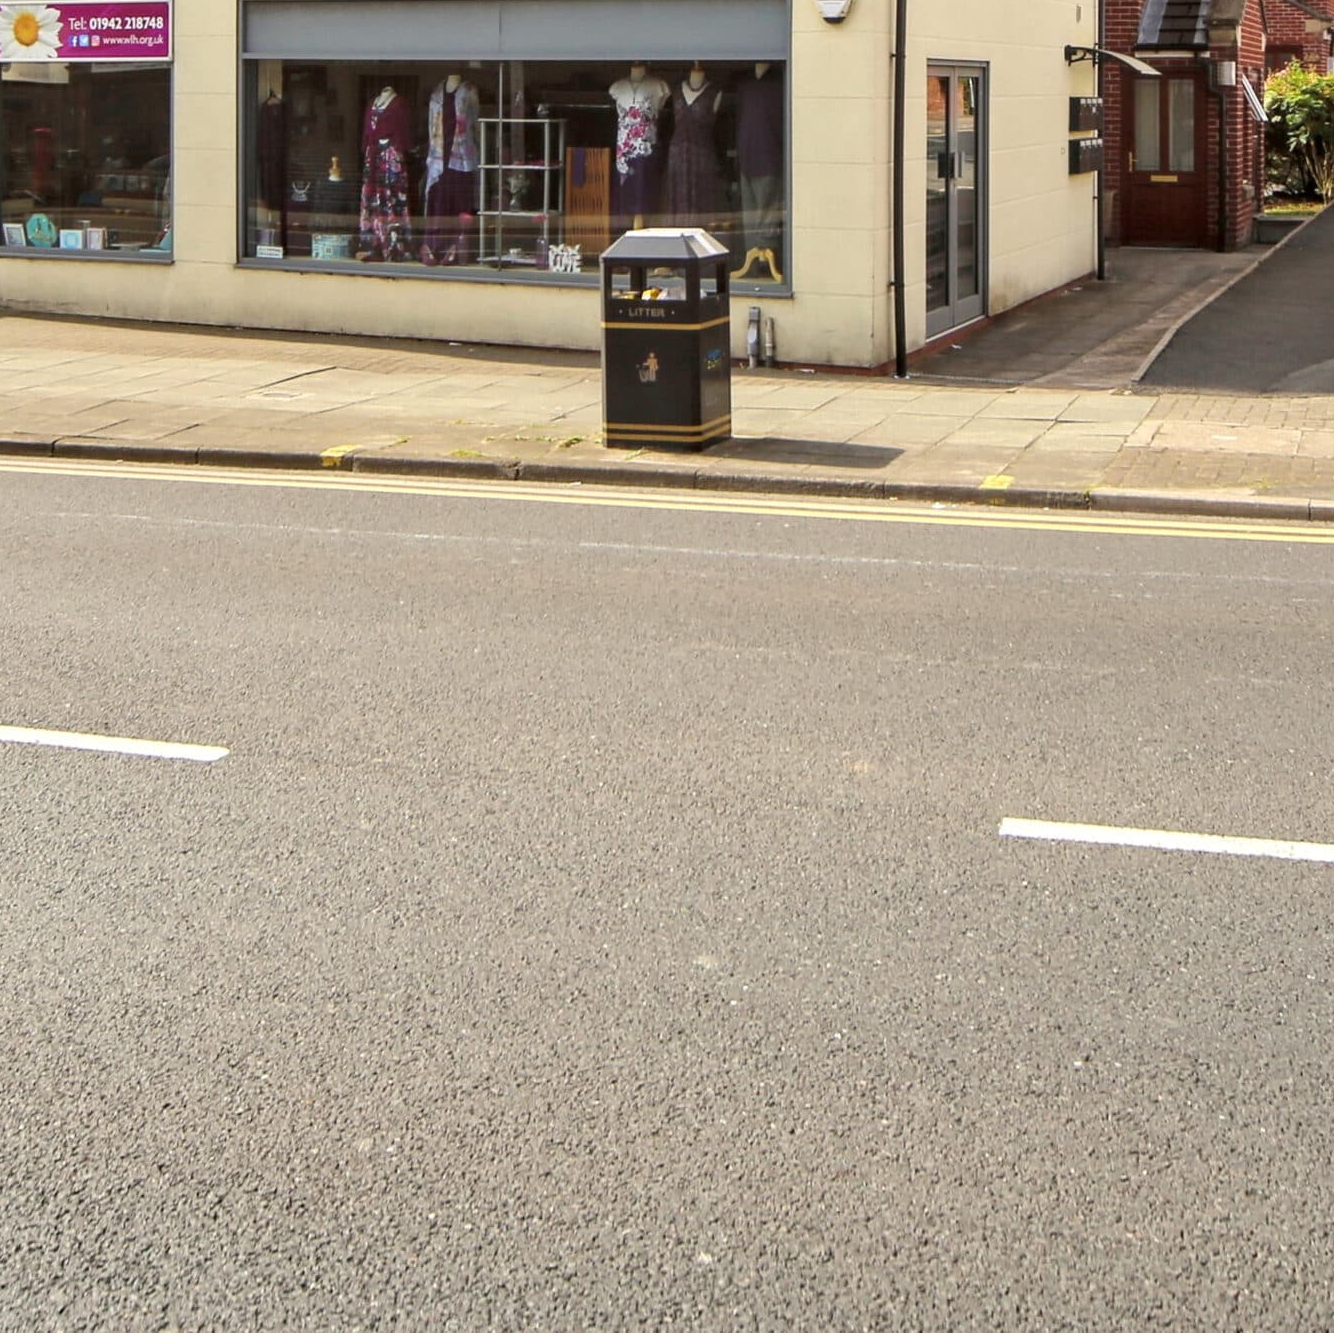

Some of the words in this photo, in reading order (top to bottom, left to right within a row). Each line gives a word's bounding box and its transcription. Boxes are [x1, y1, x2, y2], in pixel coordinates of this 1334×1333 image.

[68, 17, 87, 30] Tel:
[89, 17, 122, 30] 01942
[124, 16, 164, 30] 218748
[103, 34, 164, 47] www.wlh.org.uk
[628, 307, 666, 318] LITTER
